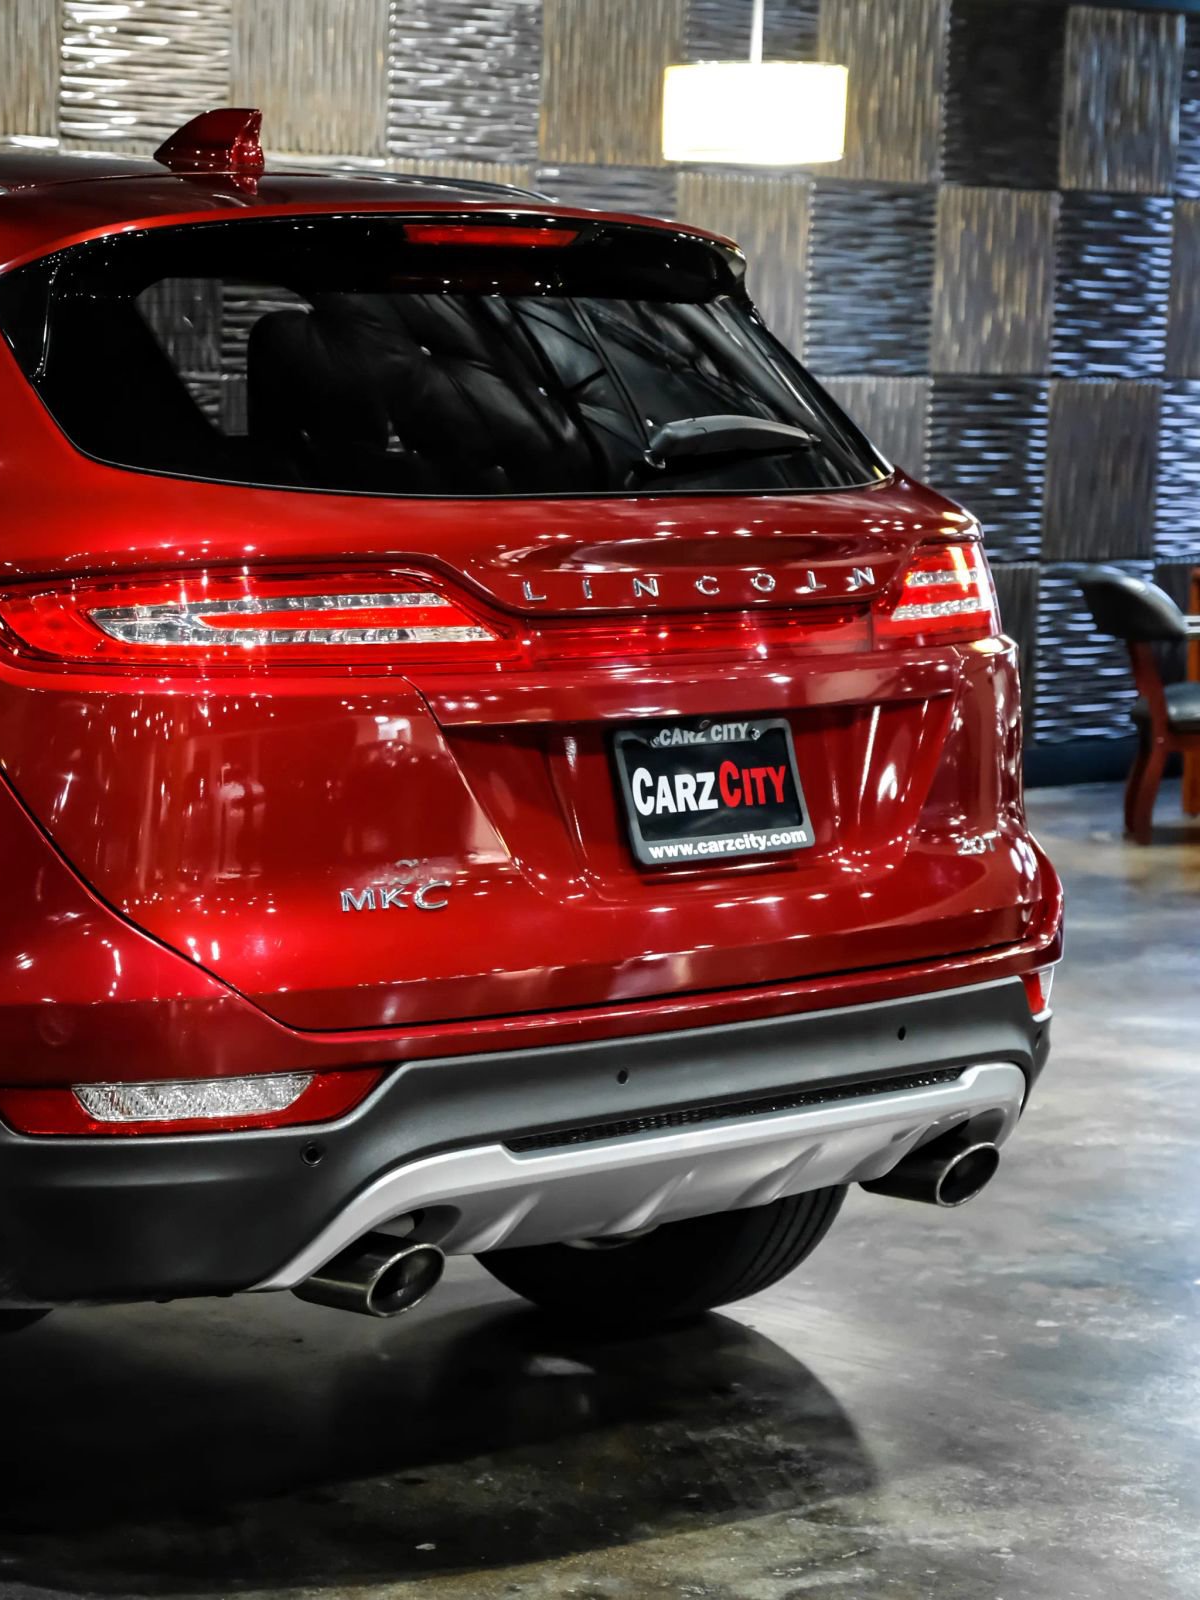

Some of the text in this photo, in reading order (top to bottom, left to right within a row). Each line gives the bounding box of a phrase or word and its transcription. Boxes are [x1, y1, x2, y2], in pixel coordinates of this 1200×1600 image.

[522, 566, 875, 601] LINCOLN
[710, 722, 749, 741] CITY
[649, 830, 807, 859] www.carzcity.com
[340, 880, 452, 912] MKC
